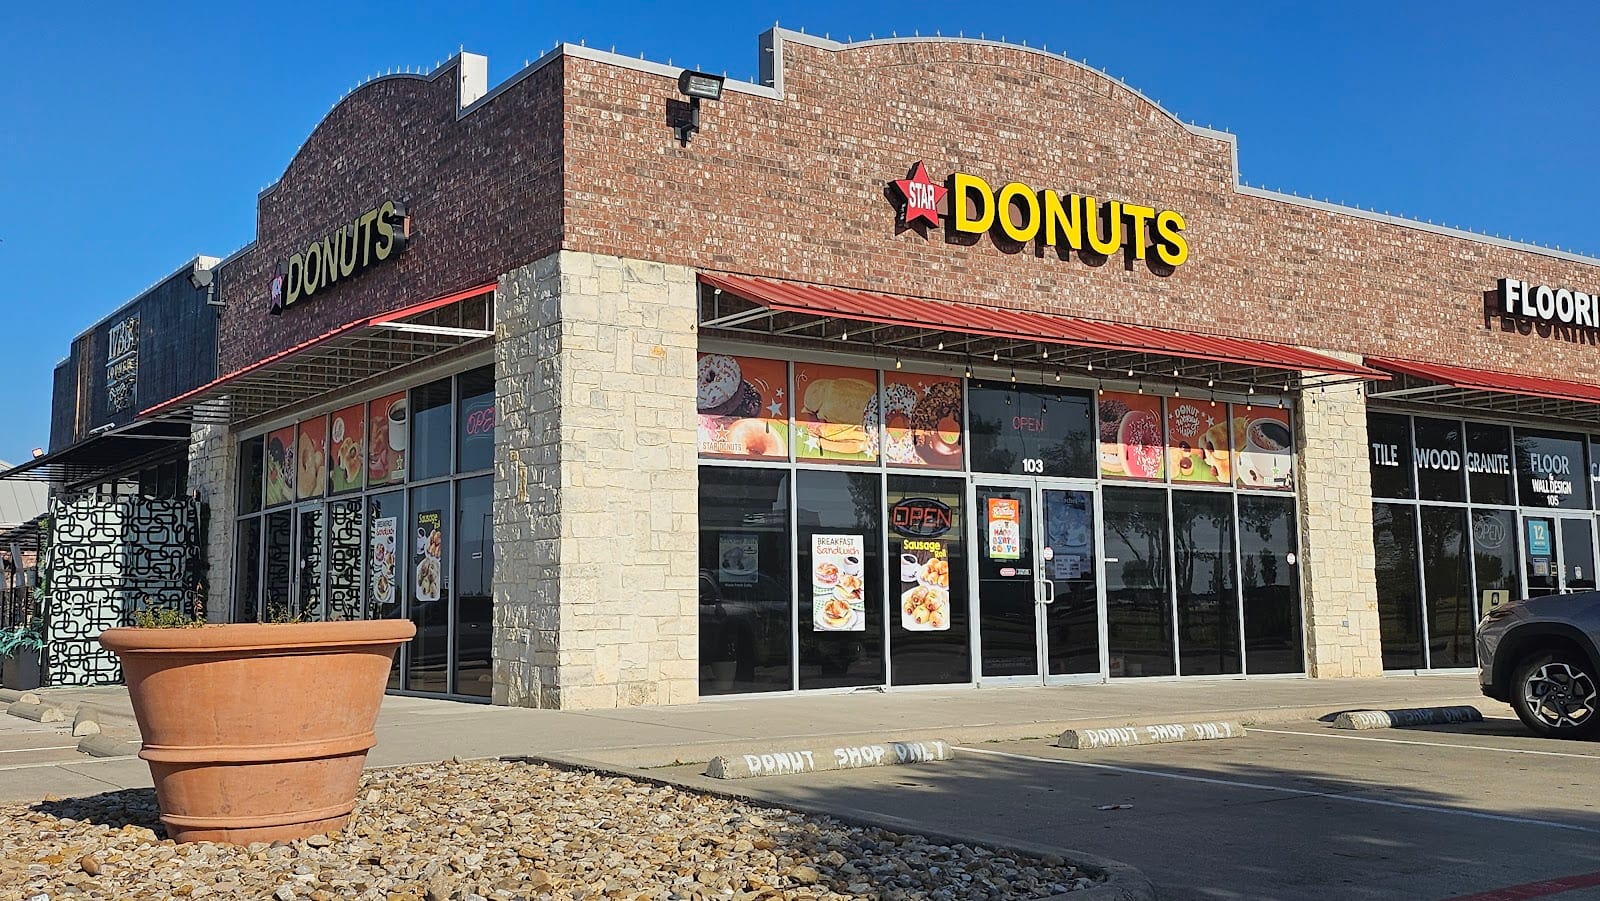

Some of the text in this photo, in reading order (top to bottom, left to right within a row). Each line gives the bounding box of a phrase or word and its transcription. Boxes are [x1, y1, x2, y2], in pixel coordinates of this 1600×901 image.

[909, 172, 1188, 267] STAR DONUTS
[285, 200, 395, 306] DONUTS
[1505, 277, 1600, 328] FLOORI
[467, 407, 496, 434] OPE
[1175, 405, 1200, 418] DONUT
[1012, 416, 1044, 432] OPEN
[702, 441, 742, 452] STAR DONUTS
[1372, 443, 1399, 467] TILE
[1022, 458, 1044, 473] 103
[1415, 447, 1460, 471] WOOD
[1467, 451, 1510, 475] GRANITE
[1530, 452, 1570, 475] FLOOR
[1531, 478, 1572, 495] WALL DESIGN
[1547, 494, 1560, 506] 105
[893, 506, 952, 529] OPEN
[1474, 522, 1502, 540] OPEN
[1533, 525, 1545, 540] 12
[816, 545, 860, 556] Sandwich
[817, 537, 854, 546] BREAKFAST
[903, 539, 941, 553] Sausage
[934, 549, 947, 559] Roll
[1085, 721, 1232, 747] DONUT SHOP ONLY
[743, 740, 944, 777] DONUT SHOP ONLY
